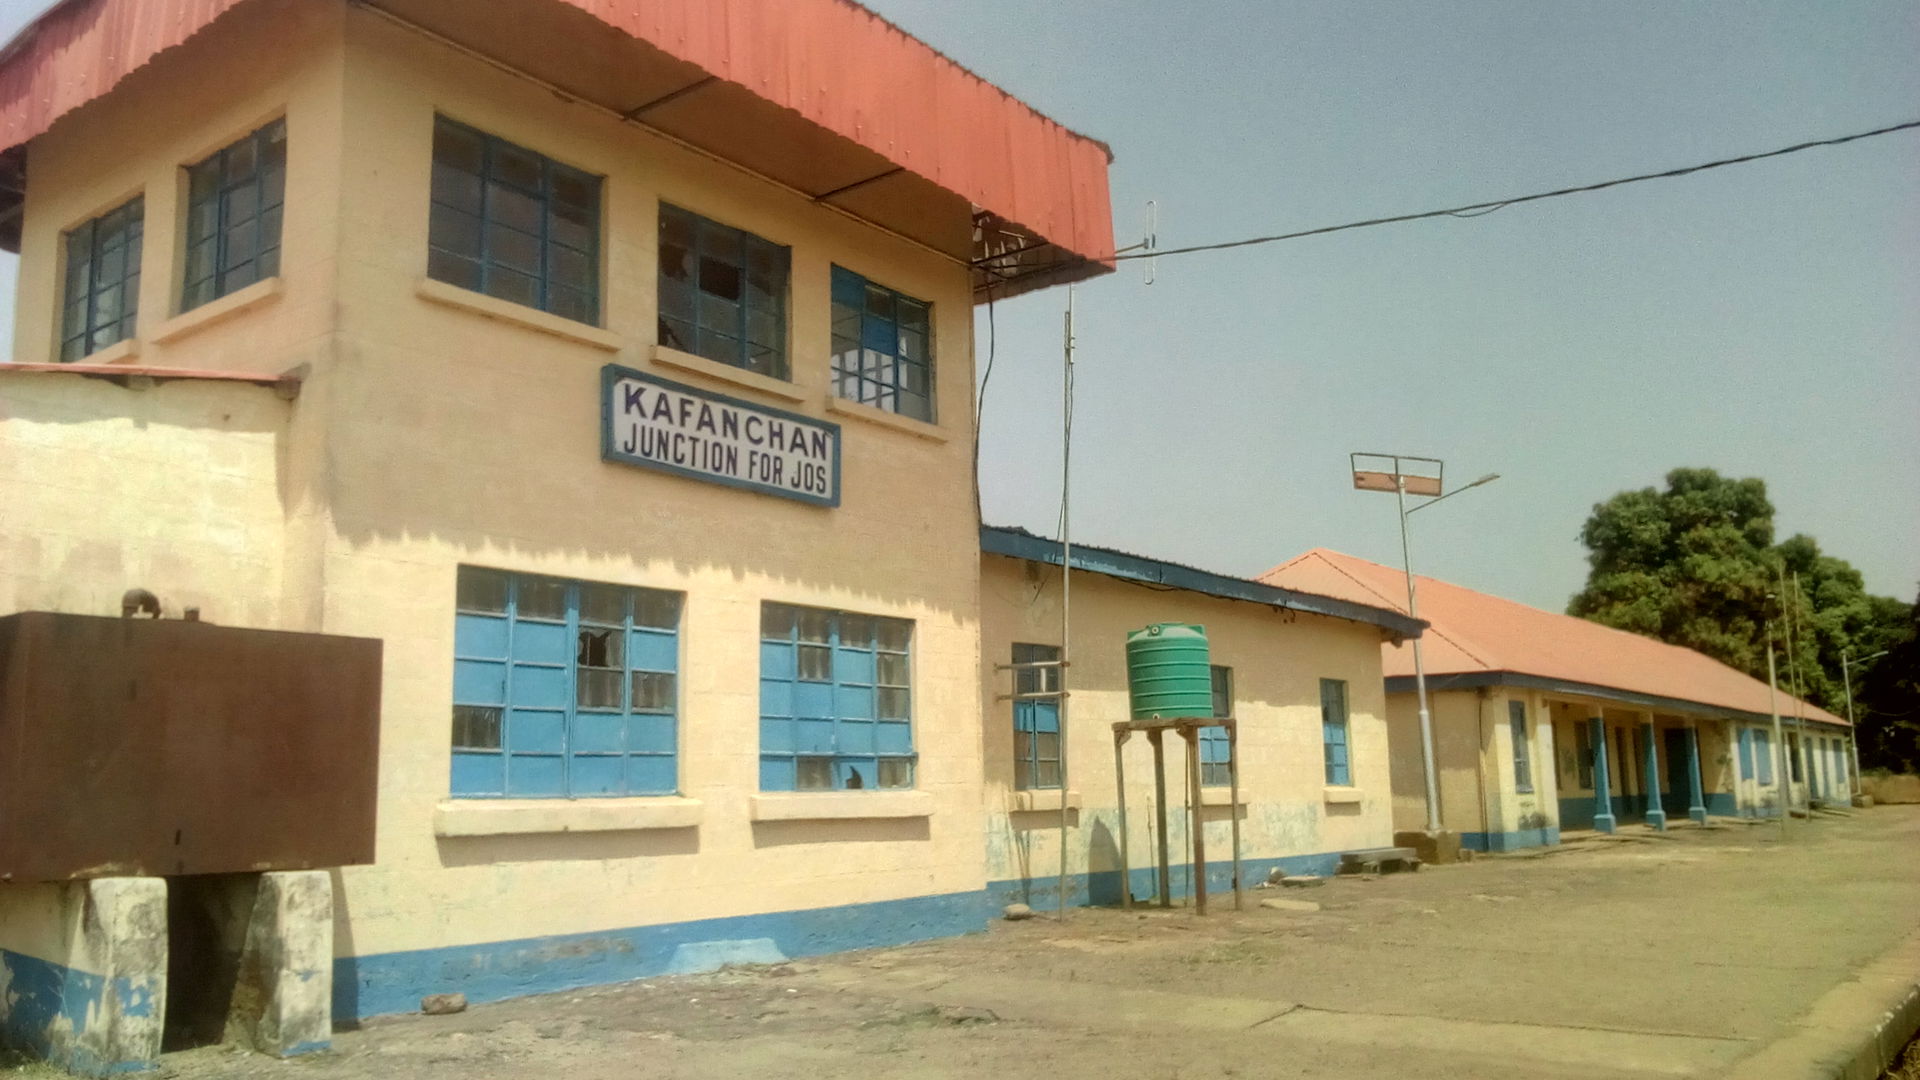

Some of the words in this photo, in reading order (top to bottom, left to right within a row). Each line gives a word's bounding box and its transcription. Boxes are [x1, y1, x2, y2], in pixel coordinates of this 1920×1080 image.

[624, 383, 827, 461] KAFANCHAN
[624, 423, 738, 476] JUNCTION
[748, 450, 783, 486] FOR
[790, 460, 827, 495] JOS
